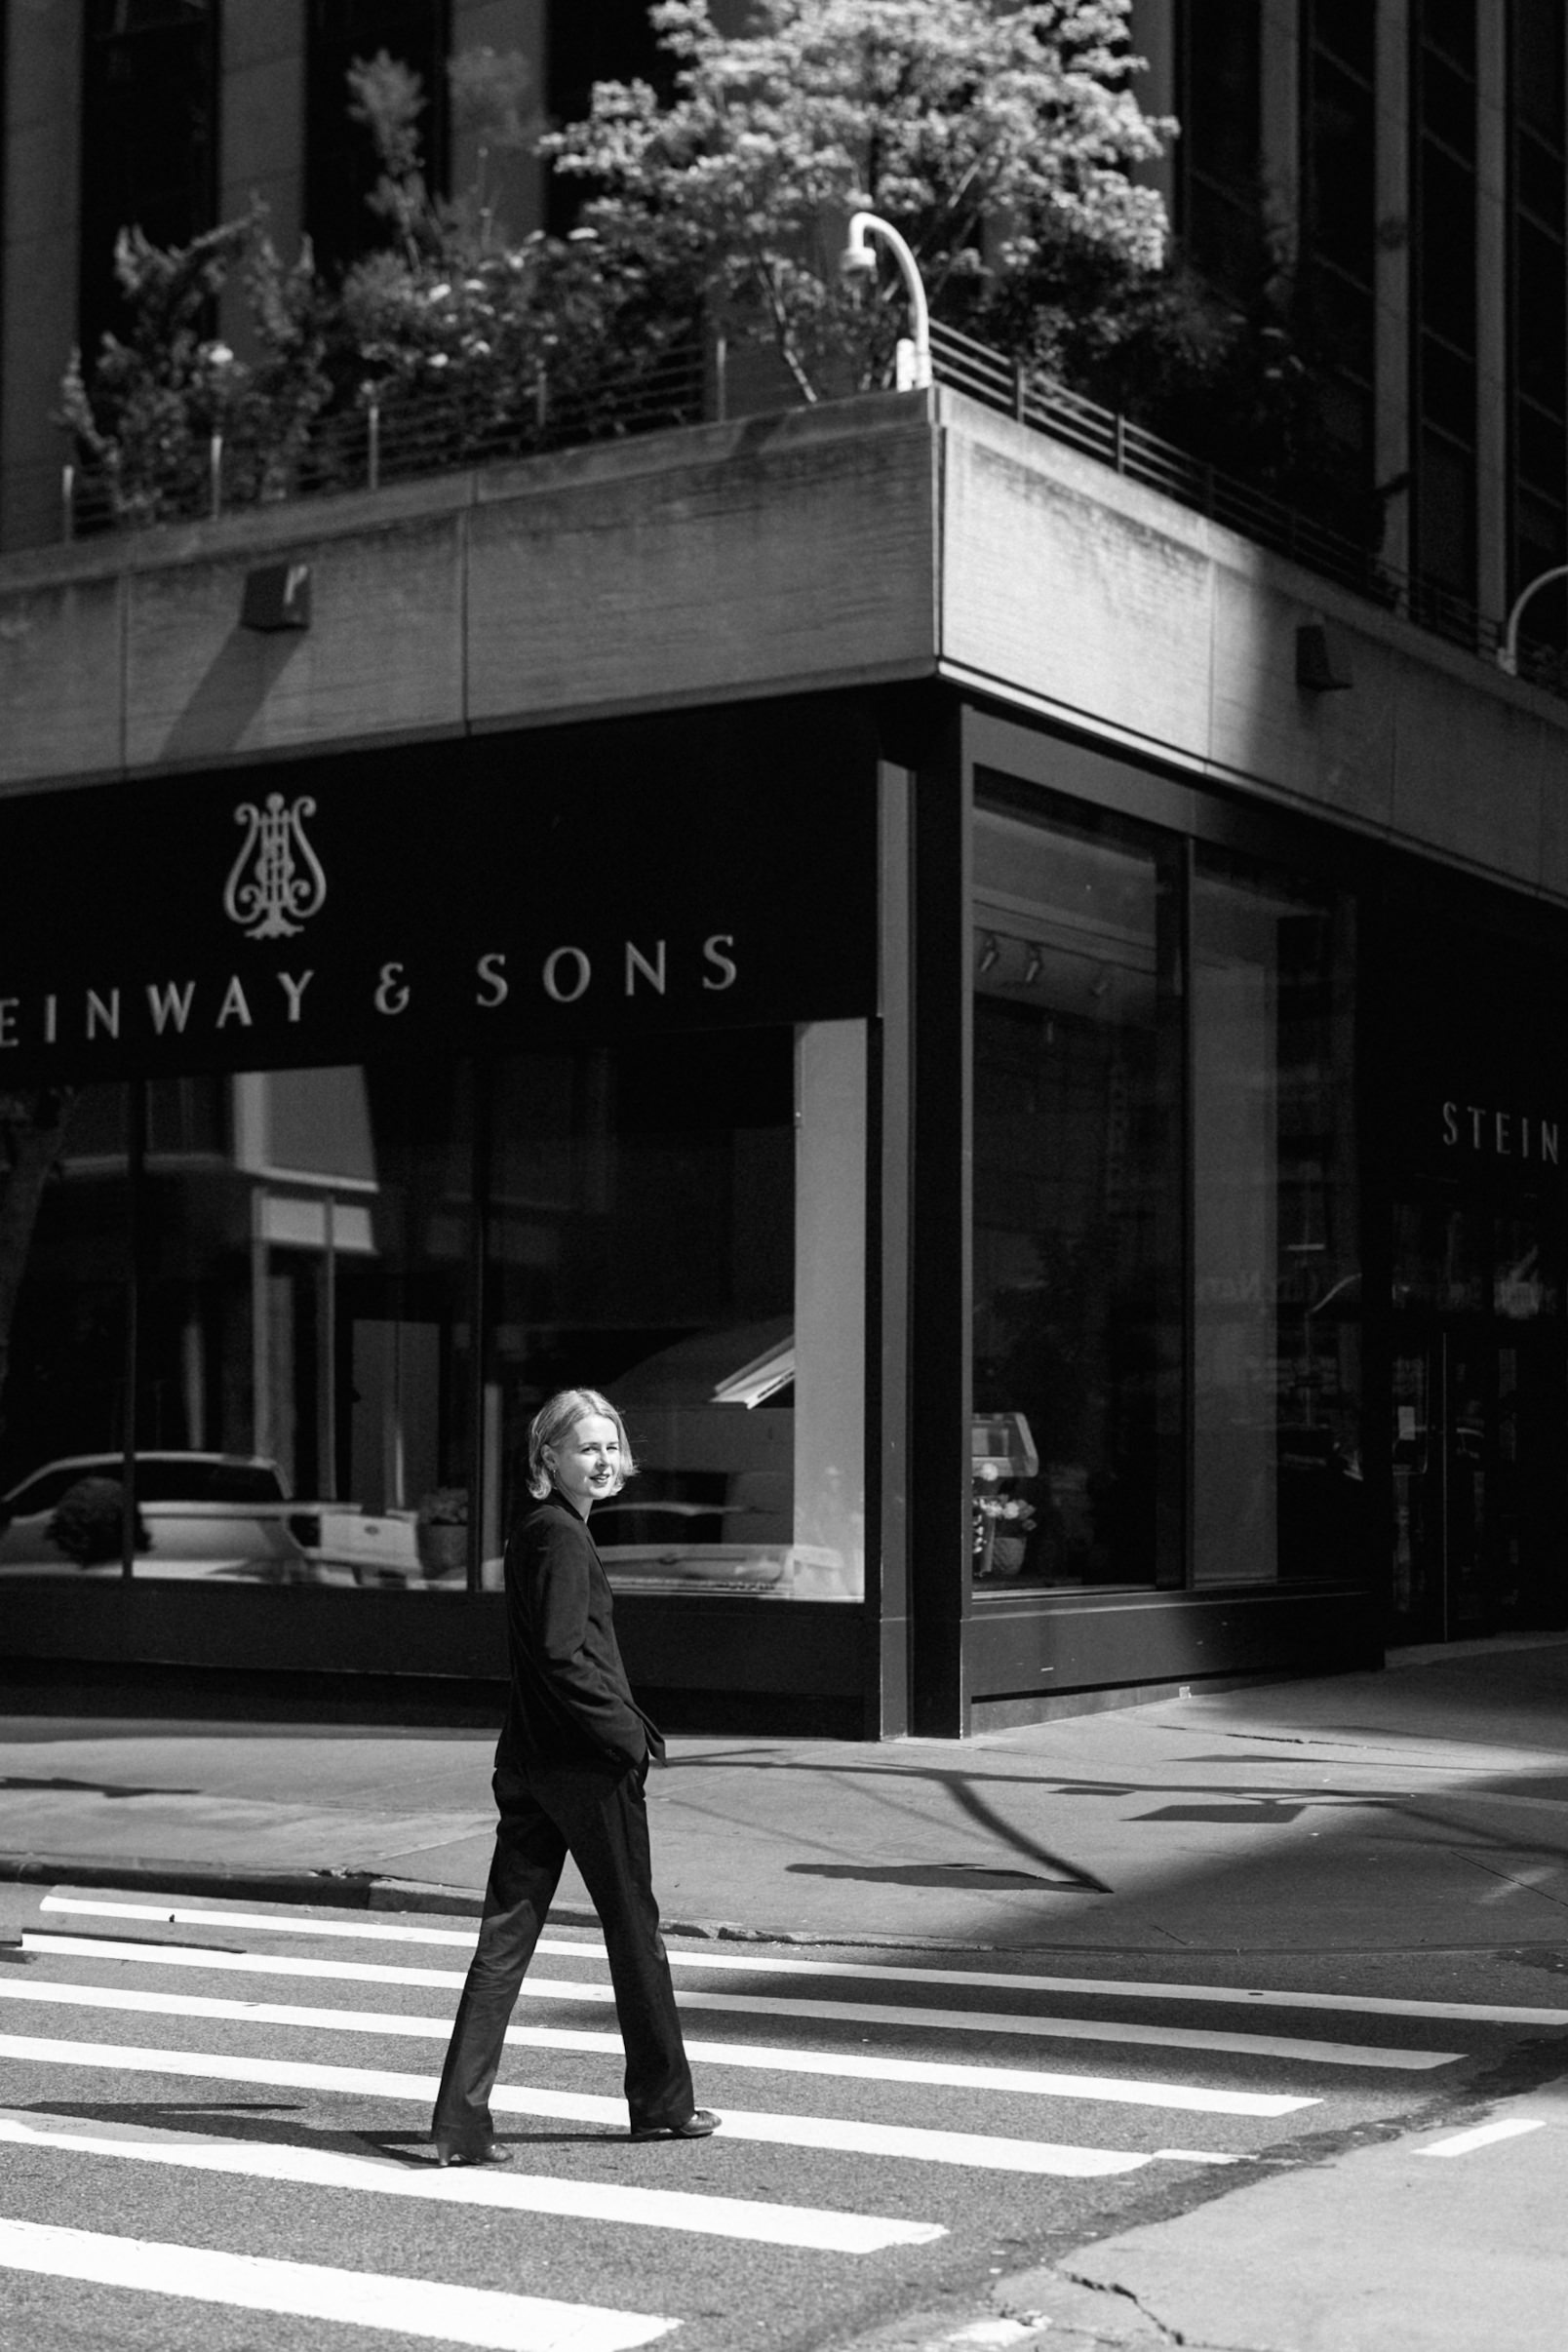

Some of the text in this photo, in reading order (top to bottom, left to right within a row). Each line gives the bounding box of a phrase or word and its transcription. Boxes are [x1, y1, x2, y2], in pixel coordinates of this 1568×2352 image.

[374, 960, 411, 1015] &
[476, 933, 738, 1007] SONS
[1442, 1100, 1559, 1164] STEIN
